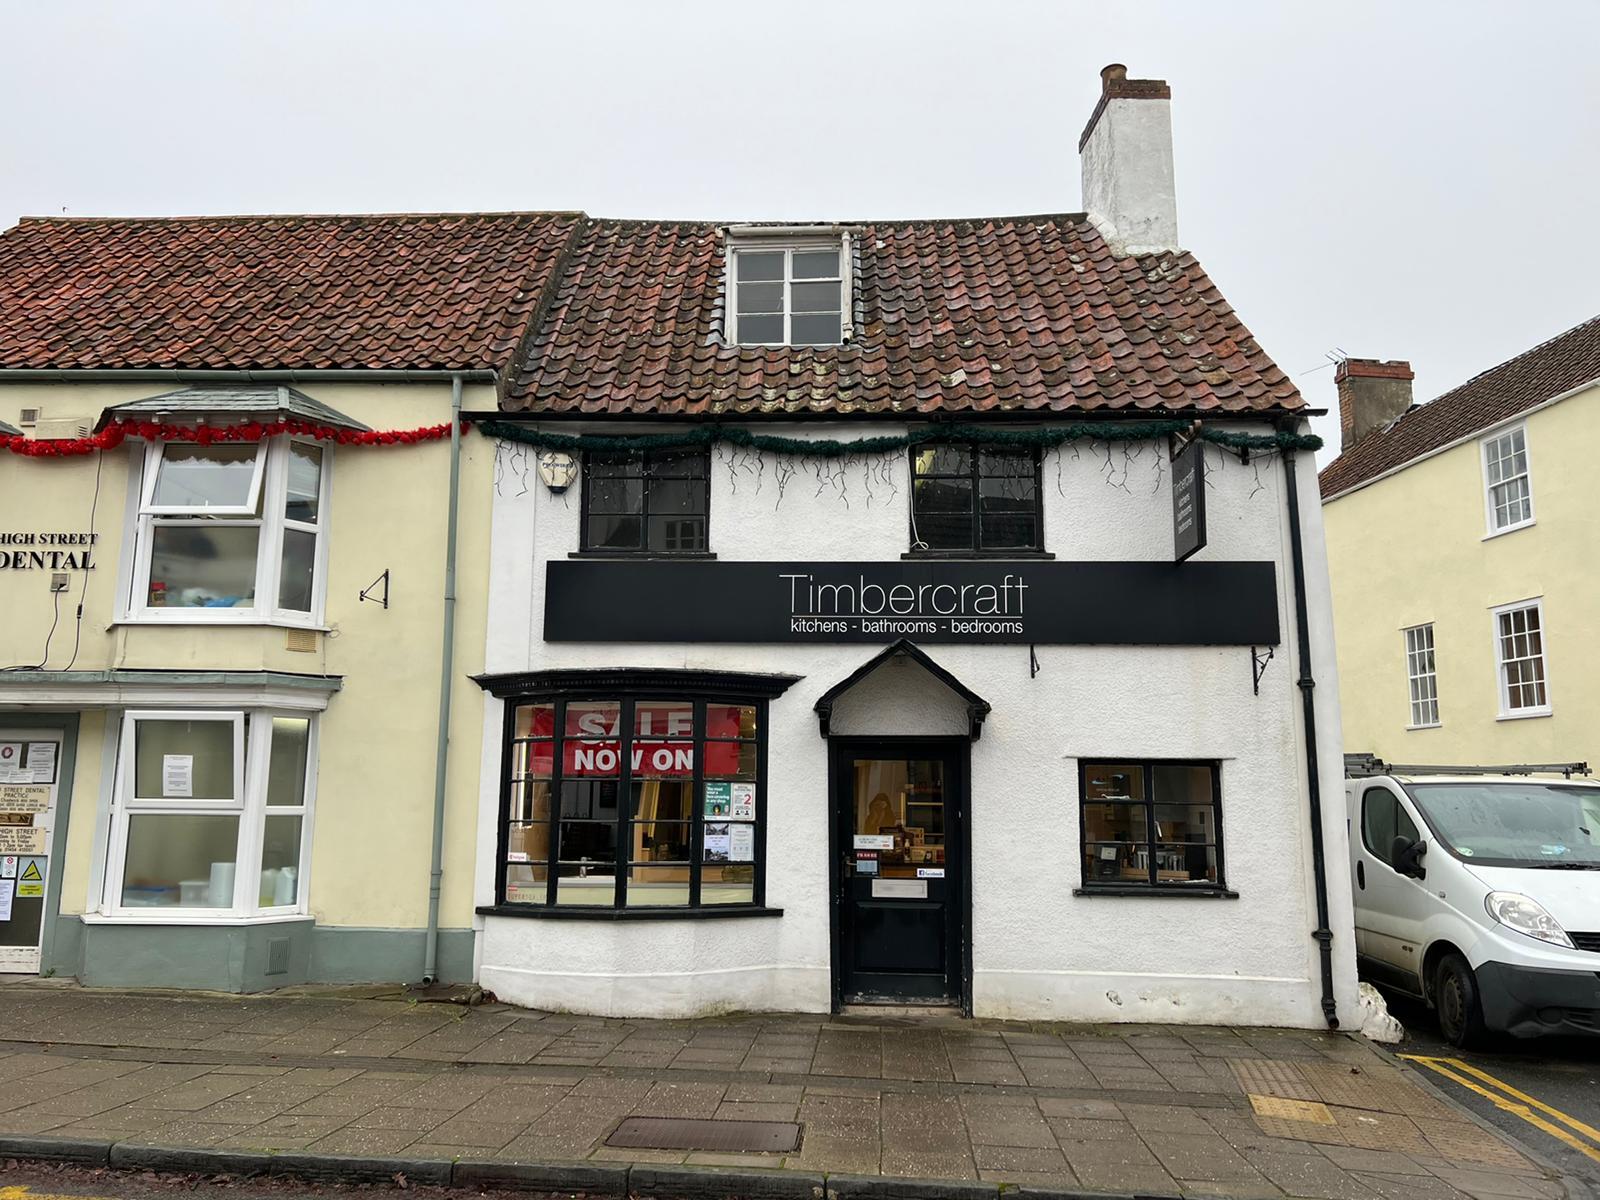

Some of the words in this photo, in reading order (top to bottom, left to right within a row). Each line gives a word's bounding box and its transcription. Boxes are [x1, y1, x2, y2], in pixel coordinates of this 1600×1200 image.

[38, 533, 98, 545] STREET
[0, 551, 96, 569] DENTAL
[779, 574, 1029, 615] Timbercraft
[790, 619, 847, 633] kitchens
[861, 619, 937, 633] bathrooms
[951, 619, 1023, 633] bedrooms
[574, 749, 644, 771] NOW
[652, 749, 694, 771] ON
[744, 794, 752, 805] 2
